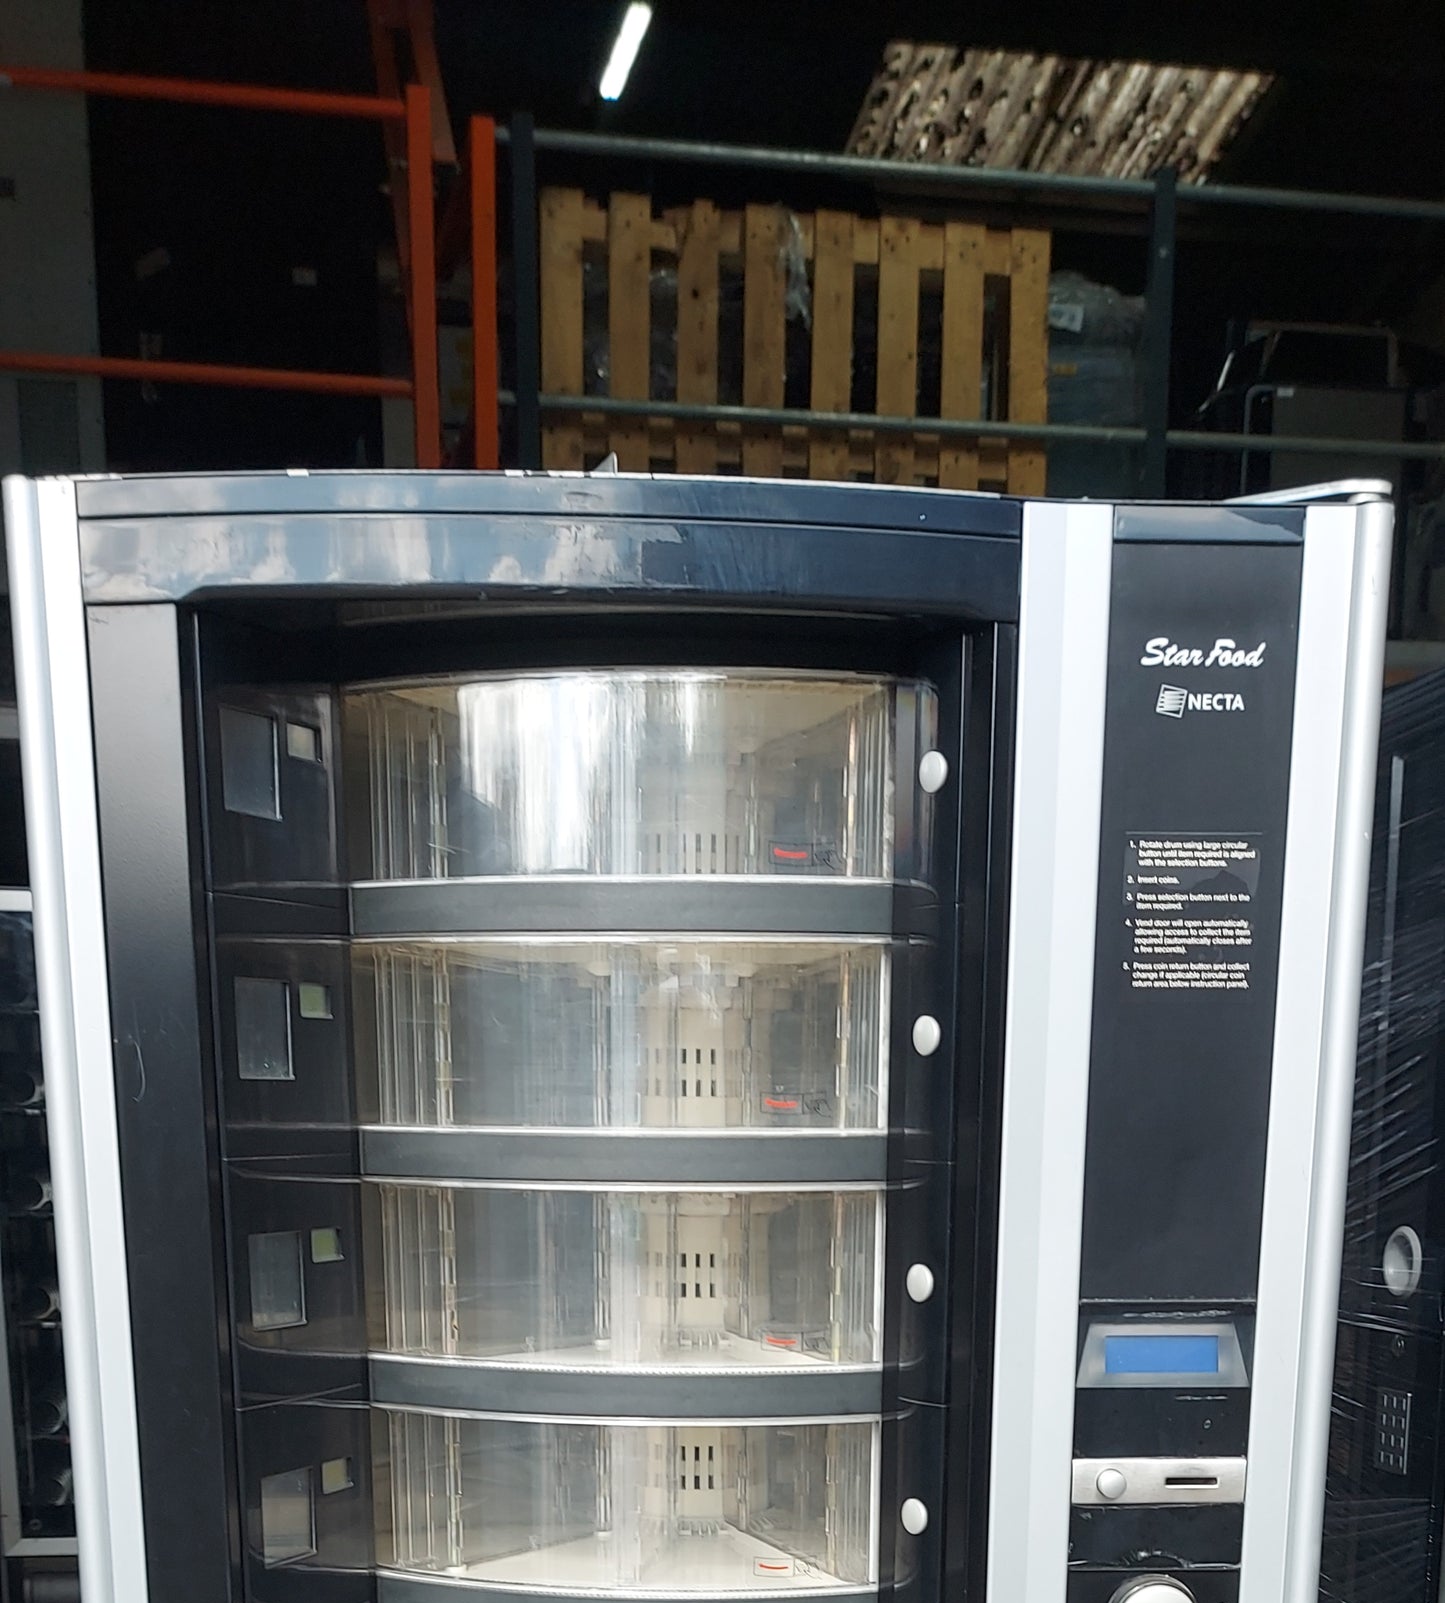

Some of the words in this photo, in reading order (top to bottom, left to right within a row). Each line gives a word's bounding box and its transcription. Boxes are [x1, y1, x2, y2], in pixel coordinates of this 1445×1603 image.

[1141, 637, 1203, 667] Star
[1205, 638, 1266, 667] Food
[1188, 693, 1245, 711] NECTA
